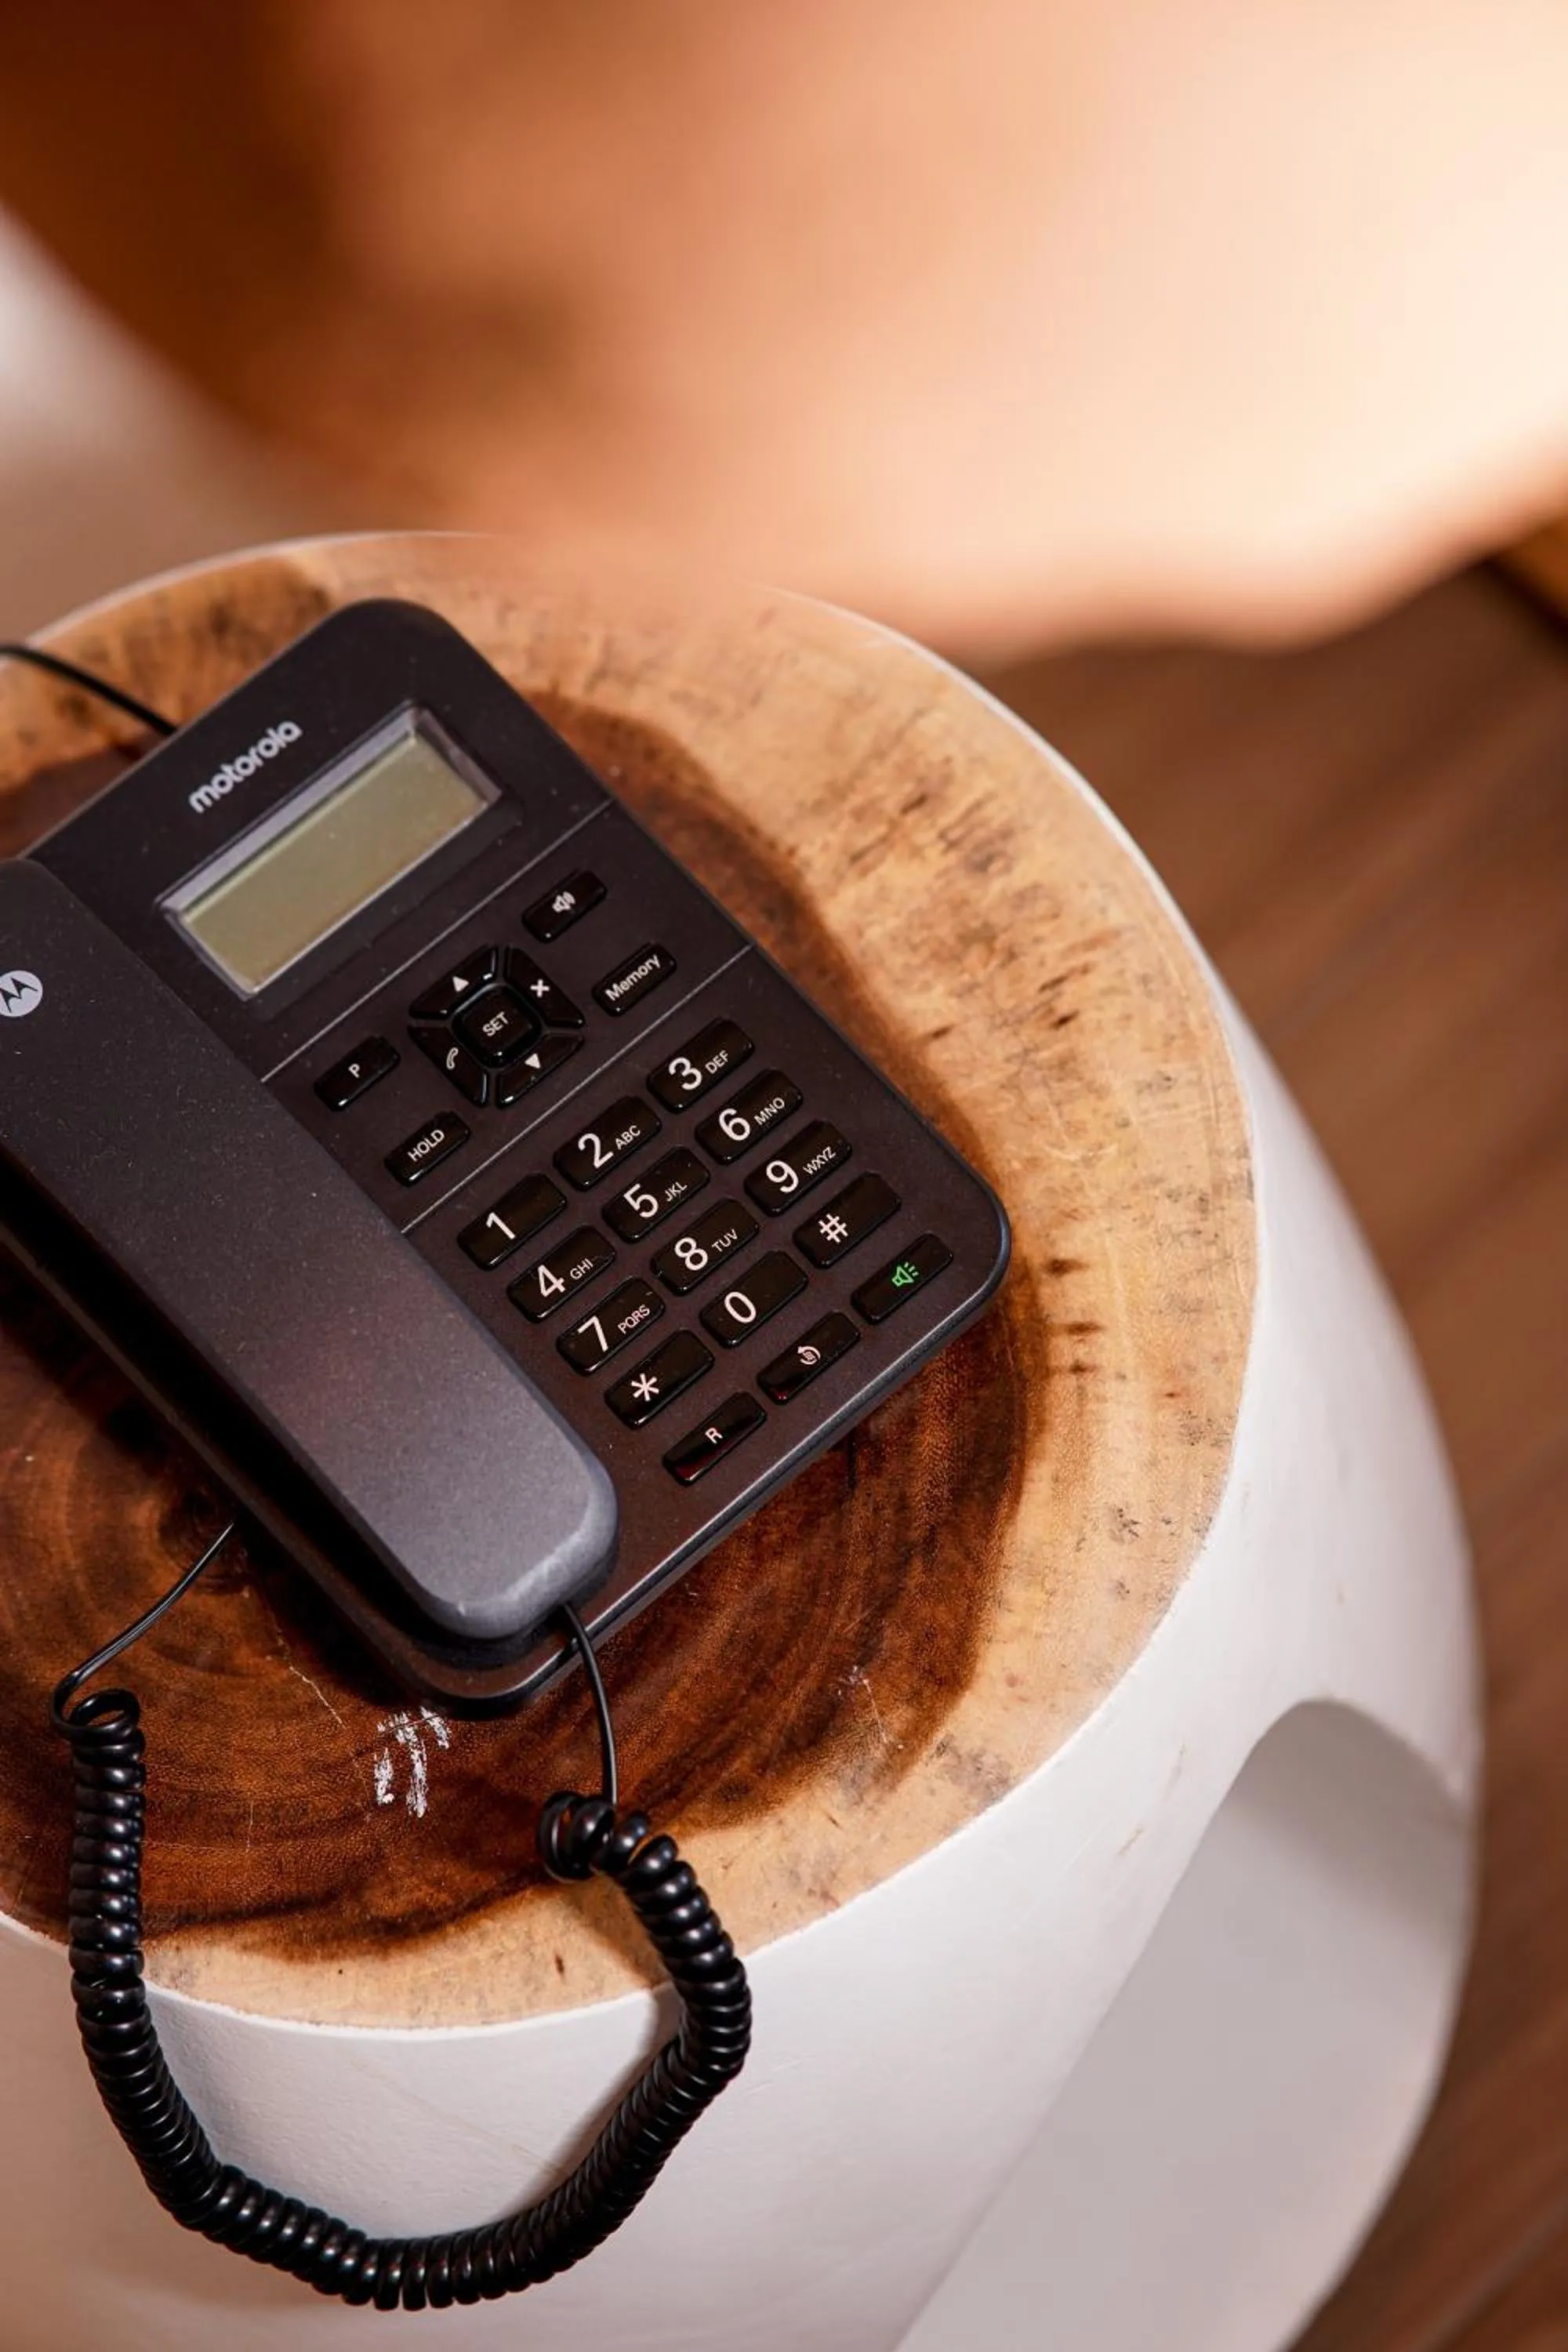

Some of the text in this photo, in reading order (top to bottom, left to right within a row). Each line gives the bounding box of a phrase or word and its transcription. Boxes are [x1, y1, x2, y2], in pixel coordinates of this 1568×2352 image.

[188, 720, 303, 814] motorola
[604, 954, 661, 1001] Memory
[482, 1011, 509, 1037] SET
[348, 1063, 361, 1078] P
[669, 1050, 728, 1091] 3 DEF
[718, 1097, 785, 1142] 6 MNO
[407, 1129, 445, 1162] HOLD
[578, 1125, 641, 1169] 2 ABC
[766, 1146, 837, 1193] 9 WXYZ
[623, 1181, 688, 1218] 5 JKL
[485, 1212, 516, 1240] 1
[674, 1229, 738, 1271] 8 TUV
[537, 1258, 593, 1298] 4 GHI
[724, 1291, 757, 1323] 0
[577, 1304, 651, 1352] 7 PQRS
[705, 1427, 723, 1444] R
